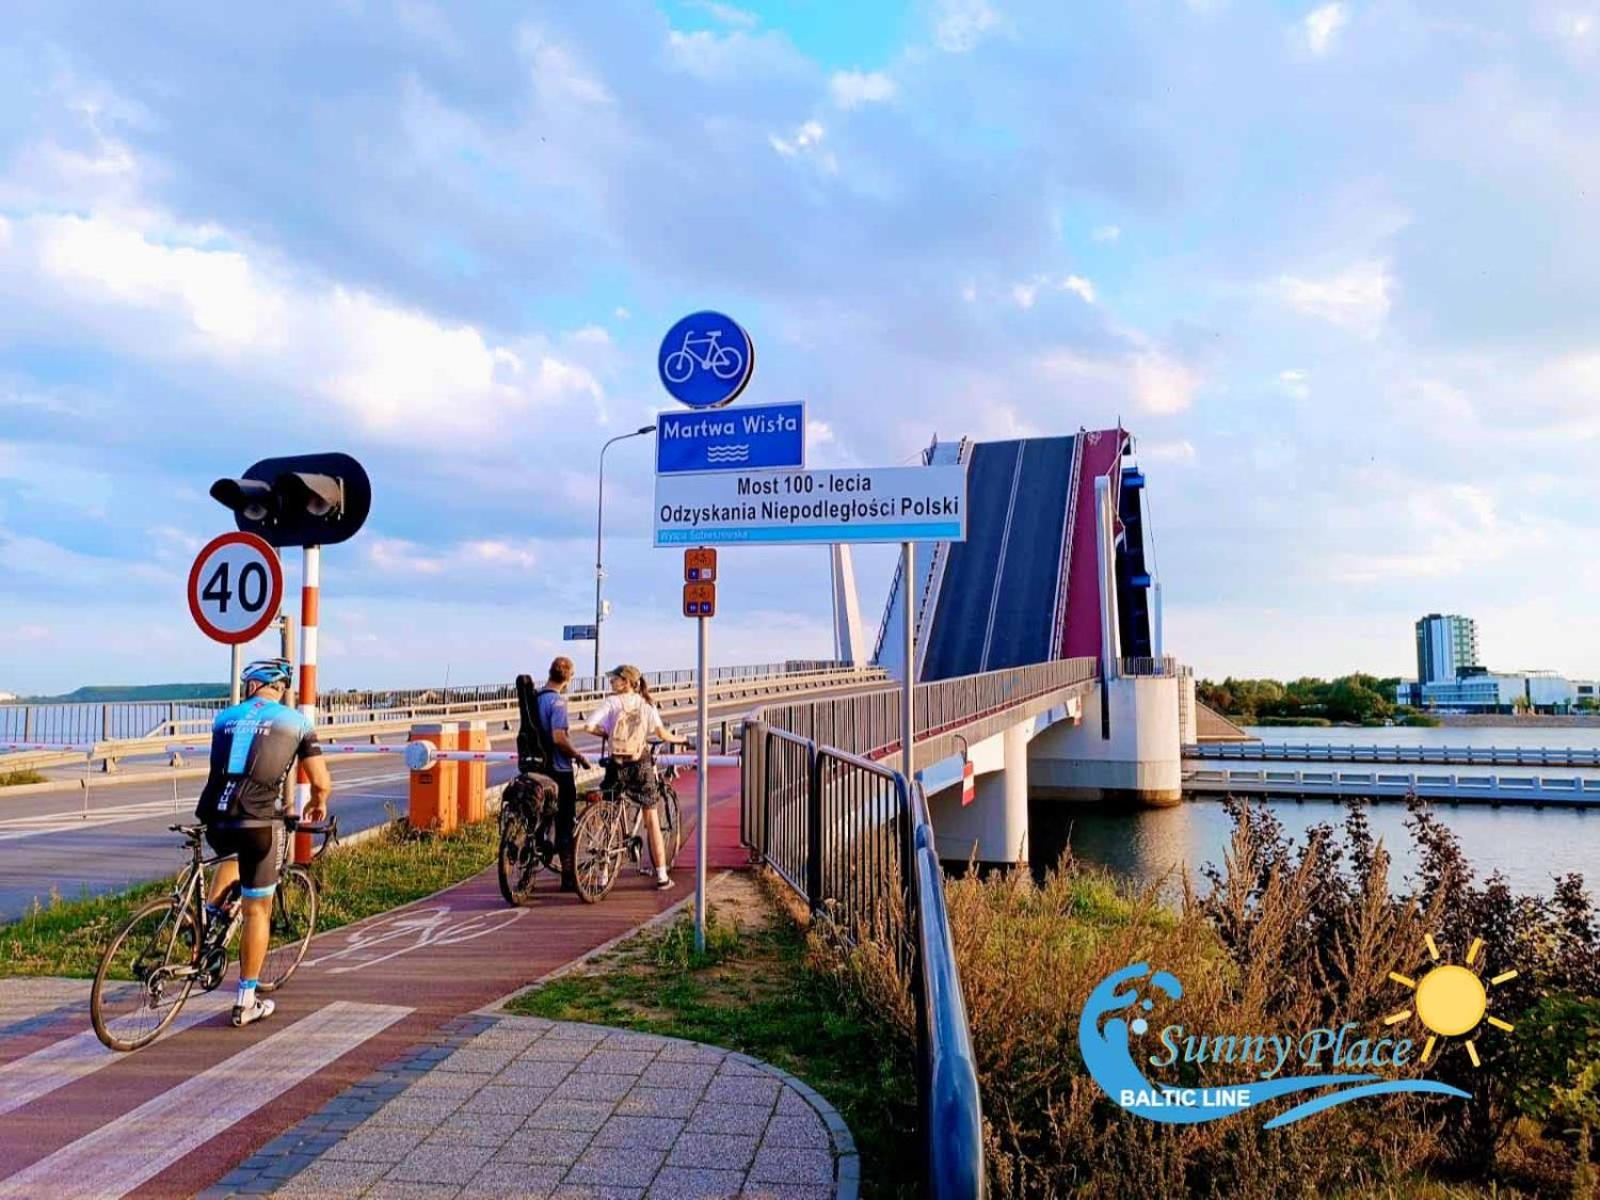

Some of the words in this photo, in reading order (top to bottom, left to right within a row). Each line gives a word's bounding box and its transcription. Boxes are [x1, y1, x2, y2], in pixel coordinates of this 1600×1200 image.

[663, 420, 735, 440] Martwa
[743, 414, 797, 434] Wisła
[737, 477, 779, 495] Most
[785, 475, 813, 493] 100
[829, 473, 871, 492] lecia
[660, 503, 756, 526] Odzyskania
[761, 497, 896, 523] Niepodległości
[900, 496, 959, 516] Polski
[202, 561, 268, 613] 40
